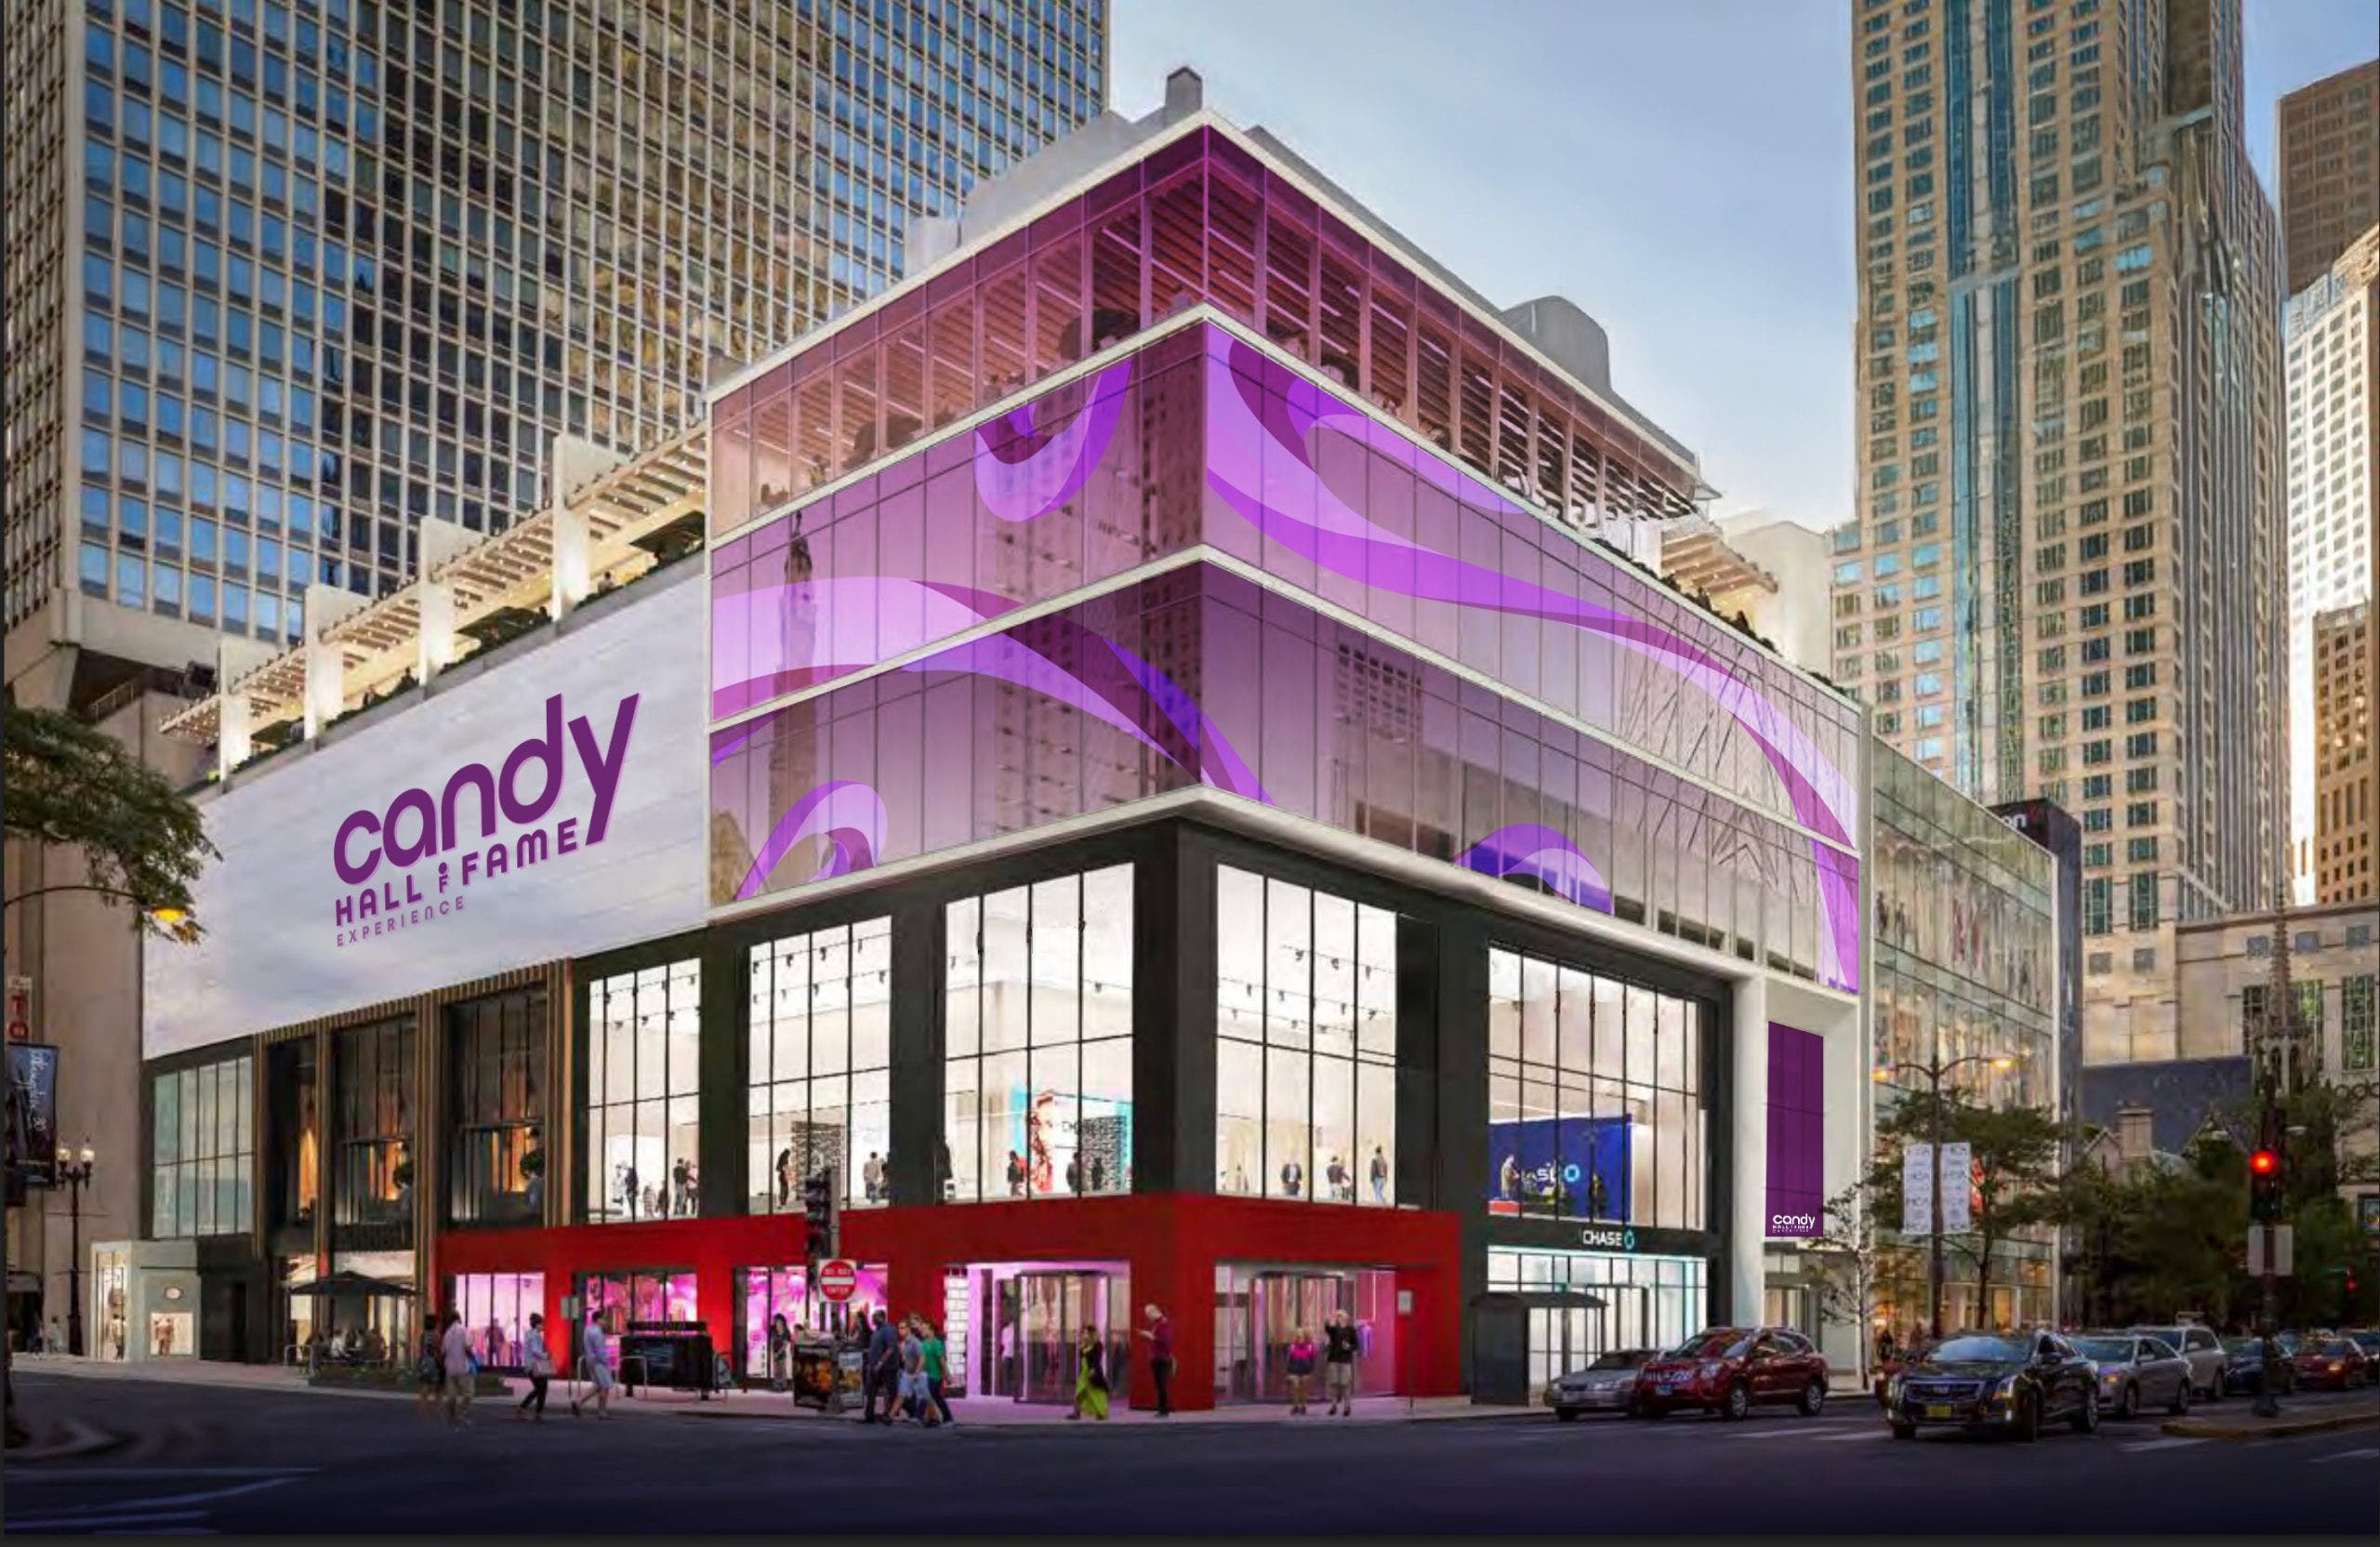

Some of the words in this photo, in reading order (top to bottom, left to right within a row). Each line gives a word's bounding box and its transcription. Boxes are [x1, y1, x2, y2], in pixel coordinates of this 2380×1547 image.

[334, 693, 640, 885] candy
[336, 875, 422, 927] HALL
[462, 817, 577, 886] FAME
[337, 895, 464, 946] EXPERIENCE
[1582, 1230, 1622, 1247] CHASE
[1772, 1213, 1816, 1230] candy
